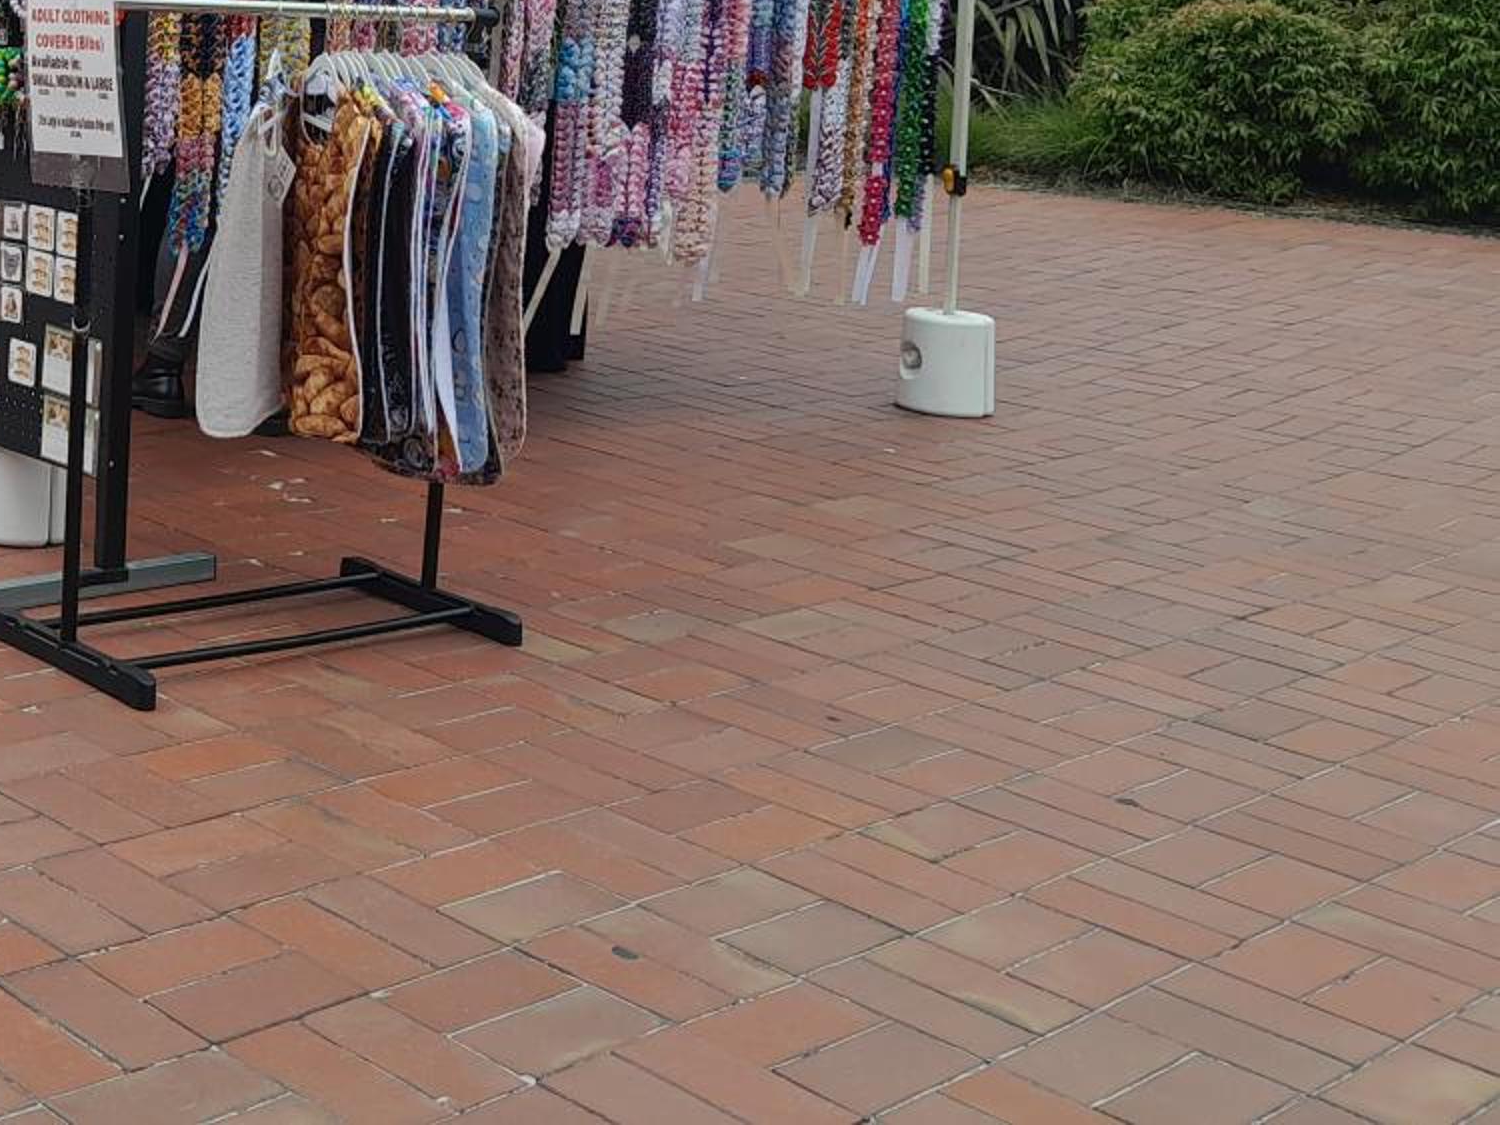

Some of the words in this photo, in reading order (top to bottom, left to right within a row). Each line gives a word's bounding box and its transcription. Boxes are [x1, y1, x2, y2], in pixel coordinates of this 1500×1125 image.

[32, 8, 60, 24] ADULT
[62, 9, 110, 25] CLOTHING
[36, 34, 73, 50] COVERS
